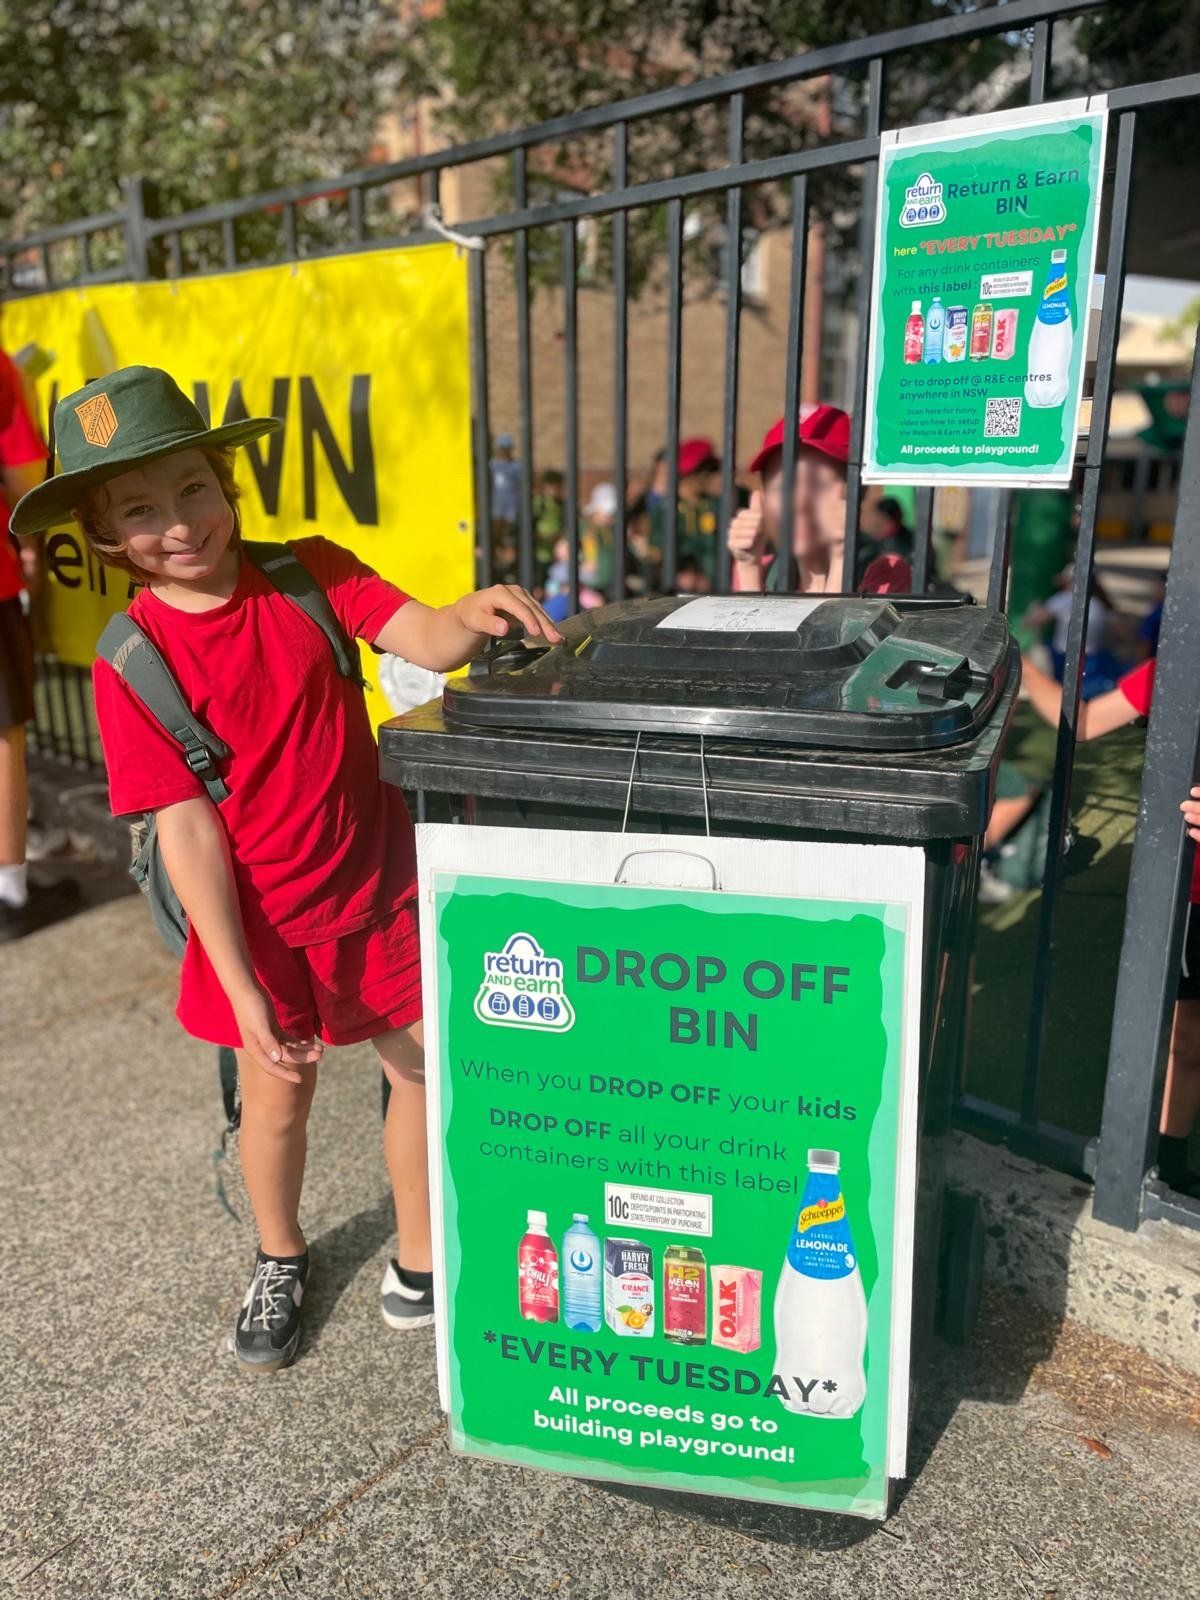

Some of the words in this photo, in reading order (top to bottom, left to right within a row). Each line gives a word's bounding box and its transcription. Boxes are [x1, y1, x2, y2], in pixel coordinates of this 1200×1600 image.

[906, 184, 942, 198] return
[947, 178, 1011, 199] Return
[1016, 173, 1028, 189] &
[1035, 168, 1079, 187] Earn
[918, 195, 941, 206] earn
[996, 195, 1028, 214] BIN
[893, 246, 917, 256] here
[898, 269, 914, 279] For
[918, 266, 937, 278] any
[941, 262, 970, 276] drink
[973, 256, 1040, 272] containers
[892, 286, 915, 297] with
[918, 283, 941, 294] this
[942, 280, 972, 292] label
[996, 319, 1006, 352] OAK
[900, 378, 911, 387] Or
[914, 378, 924, 387] to
[927, 376, 951, 388] drop
[953, 375, 968, 385] off
[971, 375, 982, 386] @
[985, 374, 1005, 384] R&E
[1008, 373, 1052, 383] centres
[899, 389, 947, 401] anywhere
[951, 389, 960, 398] in
[963, 388, 988, 398] NSW
[943, 407, 954, 415] for
[955, 407, 977, 416] funny
[958, 418, 980, 427] setup
[900, 444, 913, 454] All
[914, 444, 960, 456] proceeds
[962, 445, 973, 454] to
[975, 444, 1039, 456] playground!
[487, 954, 561, 977] return
[575, 945, 727, 993] DROP
[743, 960, 851, 1004] OFF
[487, 974, 512, 986] AND
[513, 976, 561, 995] earn
[668, 1006, 758, 1051] BIN
[460, 1058, 530, 1085] When
[537, 1071, 581, 1092] you
[589, 1074, 664, 1100] DROP
[670, 1083, 721, 1105] OFF
[728, 1093, 789, 1114] your
[797, 1096, 857, 1121] kids
[490, 1107, 558, 1133] DROP
[564, 1118, 611, 1140] OFF
[618, 1125, 645, 1144] all
[653, 1131, 711, 1152] your
[719, 1135, 786, 1161] drink
[479, 1141, 609, 1172] containers
[616, 1157, 671, 1179] with
[679, 1163, 727, 1186] this
[735, 1168, 798, 1194] label
[608, 1195, 629, 1219] 10c
[649, 1194, 656, 1202] AT
[656, 1195, 685, 1206] COLLECTION
[673, 1208, 707, 1219] PARTICIPATING
[671, 1217, 677, 1226] OF
[678, 1218, 703, 1230] PURCHASE
[810, 1232, 834, 1240] CLASSIC
[796, 1239, 849, 1253] LEMONADE
[621, 1251, 650, 1263] HARVEY
[623, 1262, 649, 1273] FRESH
[668, 1266, 700, 1280] H2
[668, 1279, 700, 1288] MELON
[719, 1279, 737, 1338] OAK
[548, 1385, 579, 1406] All
[585, 1394, 704, 1424] proceeds
[710, 1412, 744, 1431] go
[750, 1415, 778, 1433] to
[533, 1409, 633, 1446] building
[639, 1429, 796, 1464] playground!
